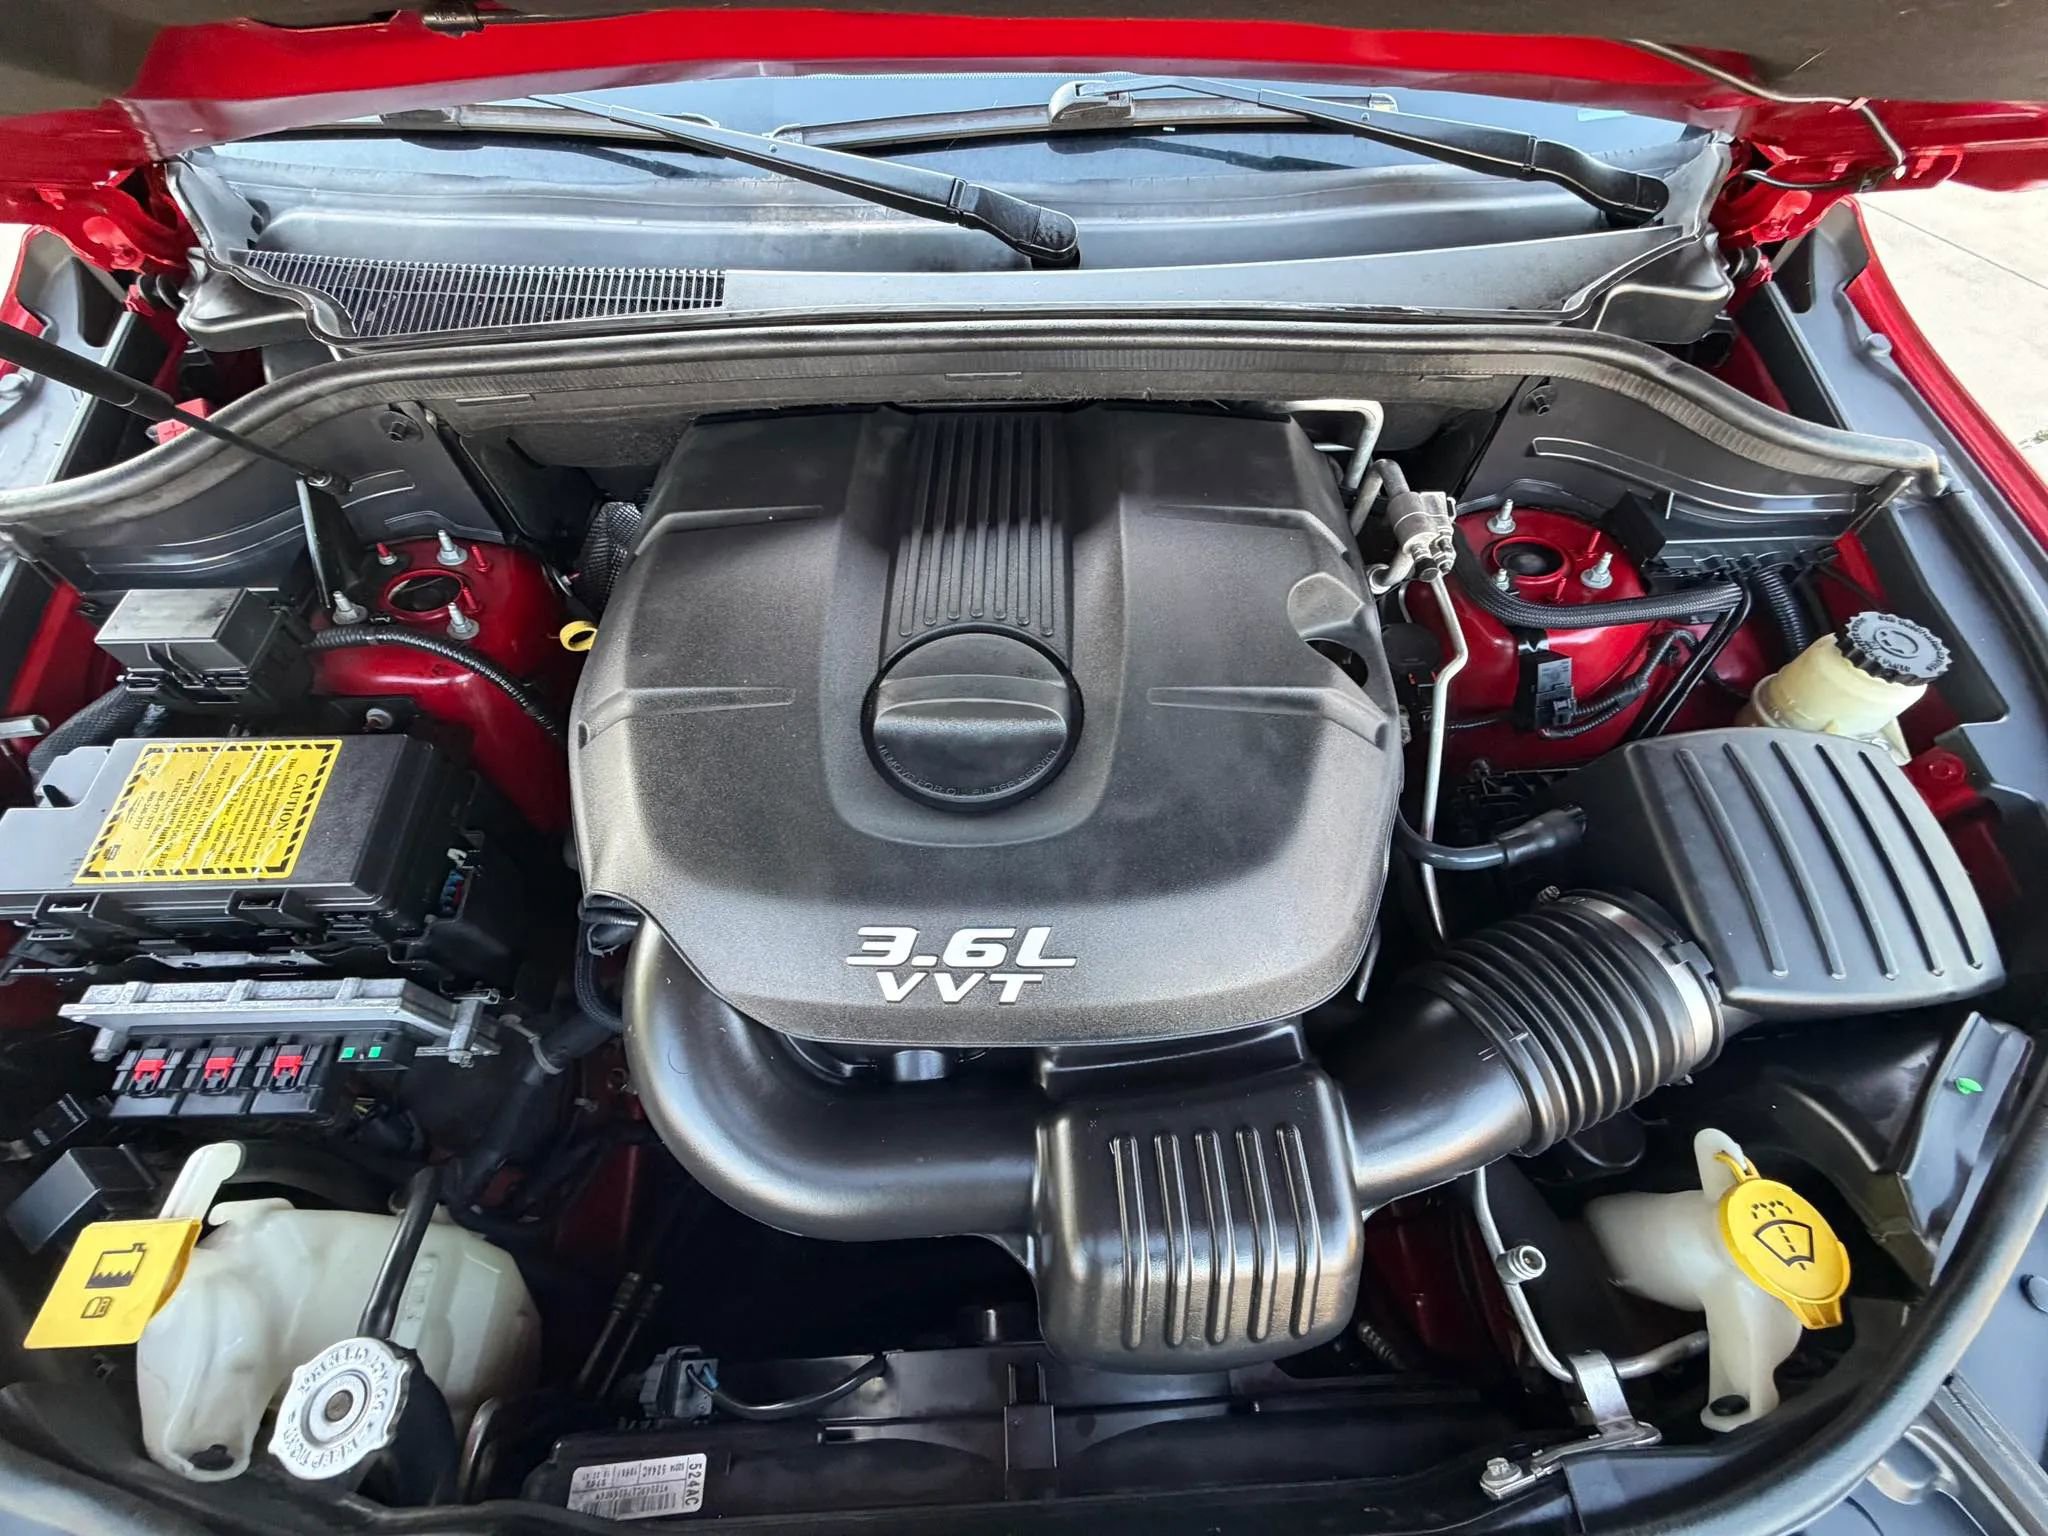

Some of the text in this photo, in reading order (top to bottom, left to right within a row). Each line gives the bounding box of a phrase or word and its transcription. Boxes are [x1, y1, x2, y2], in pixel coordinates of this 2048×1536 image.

[219, 762, 232, 775] FOR
[286, 758, 298, 769] This
[204, 777, 225, 808] FACTORY
[277, 771, 293, 790] vehicle
[192, 782, 212, 811] SERVICE
[242, 798, 259, 822] training
[273, 773, 309, 831] CAUTION
[228, 809, 243, 826] Many
[262, 797, 281, 825] equipped
[235, 833, 255, 862] computer
[257, 827, 269, 840] with
[846, 926, 1078, 967] 3.6L
[876, 971, 1044, 1004] VVT
[684, 1463, 702, 1506] 524AC
